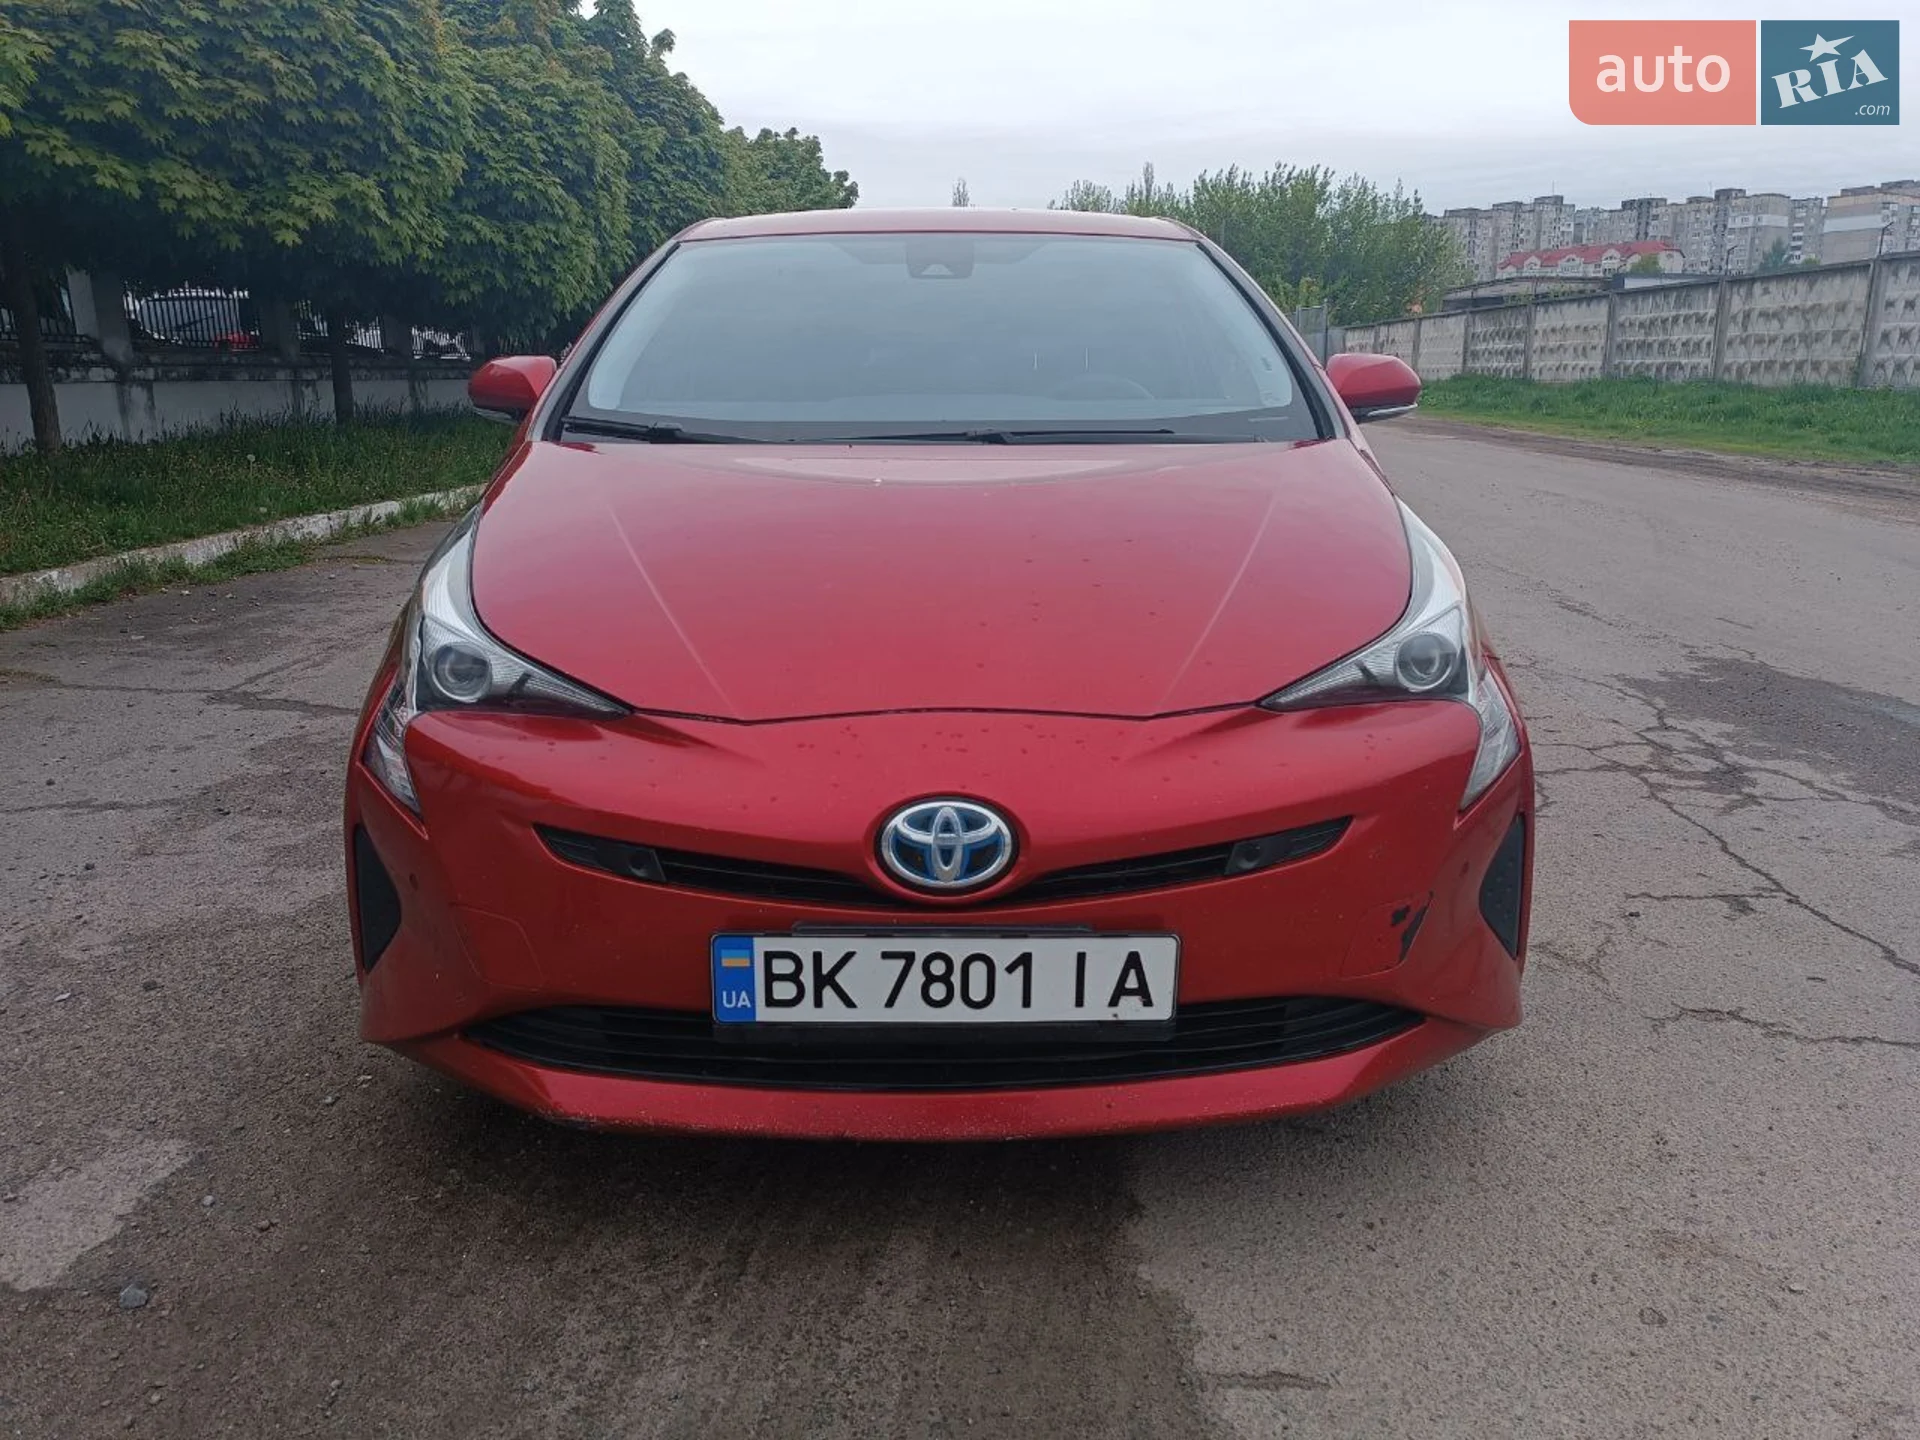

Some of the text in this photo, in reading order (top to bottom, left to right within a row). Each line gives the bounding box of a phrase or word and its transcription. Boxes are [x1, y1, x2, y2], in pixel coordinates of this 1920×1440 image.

[763, 950, 858, 1009] BK
[880, 950, 1033, 1009] 7801
[722, 991, 751, 1008] UA
